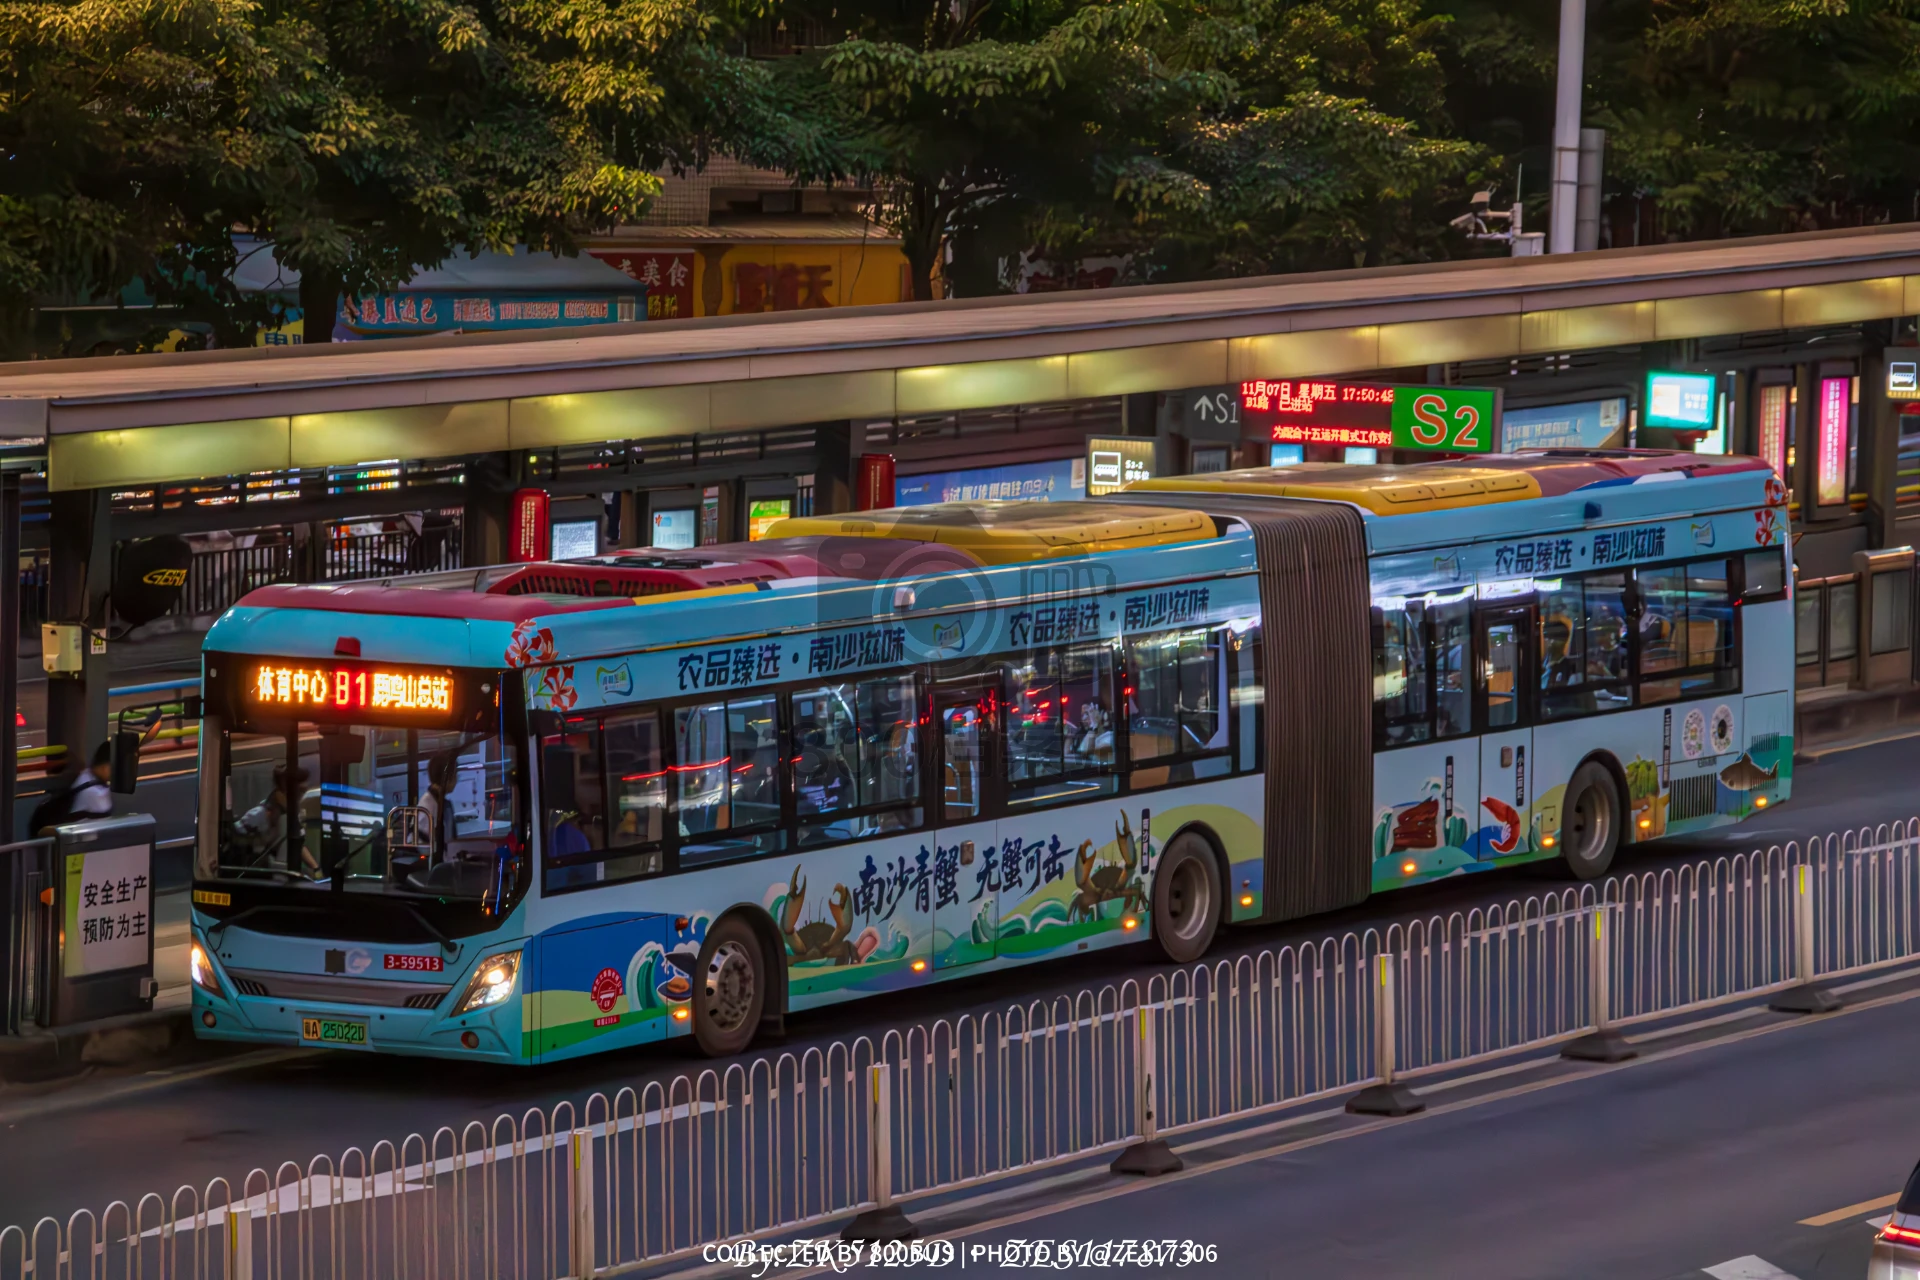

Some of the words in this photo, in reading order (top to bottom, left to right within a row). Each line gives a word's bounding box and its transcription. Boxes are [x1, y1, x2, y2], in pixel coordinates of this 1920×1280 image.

[1214, 392, 1239, 424] S1
[1242, 380, 1291, 398] 11月07日
[1298, 383, 1337, 401] 星期五
[1278, 396, 1314, 413] 已进站
[1410, 393, 1480, 448] S2
[257, 666, 328, 703] 体育中心
[335, 670, 367, 706] B1
[83, 874, 148, 909] 安全生产
[853, 844, 960, 926] 南沙青蟹
[968, 834, 1076, 904] 无蟹可击
[82, 910, 147, 945] 预防为主
[387, 955, 440, 972] 3-59513
